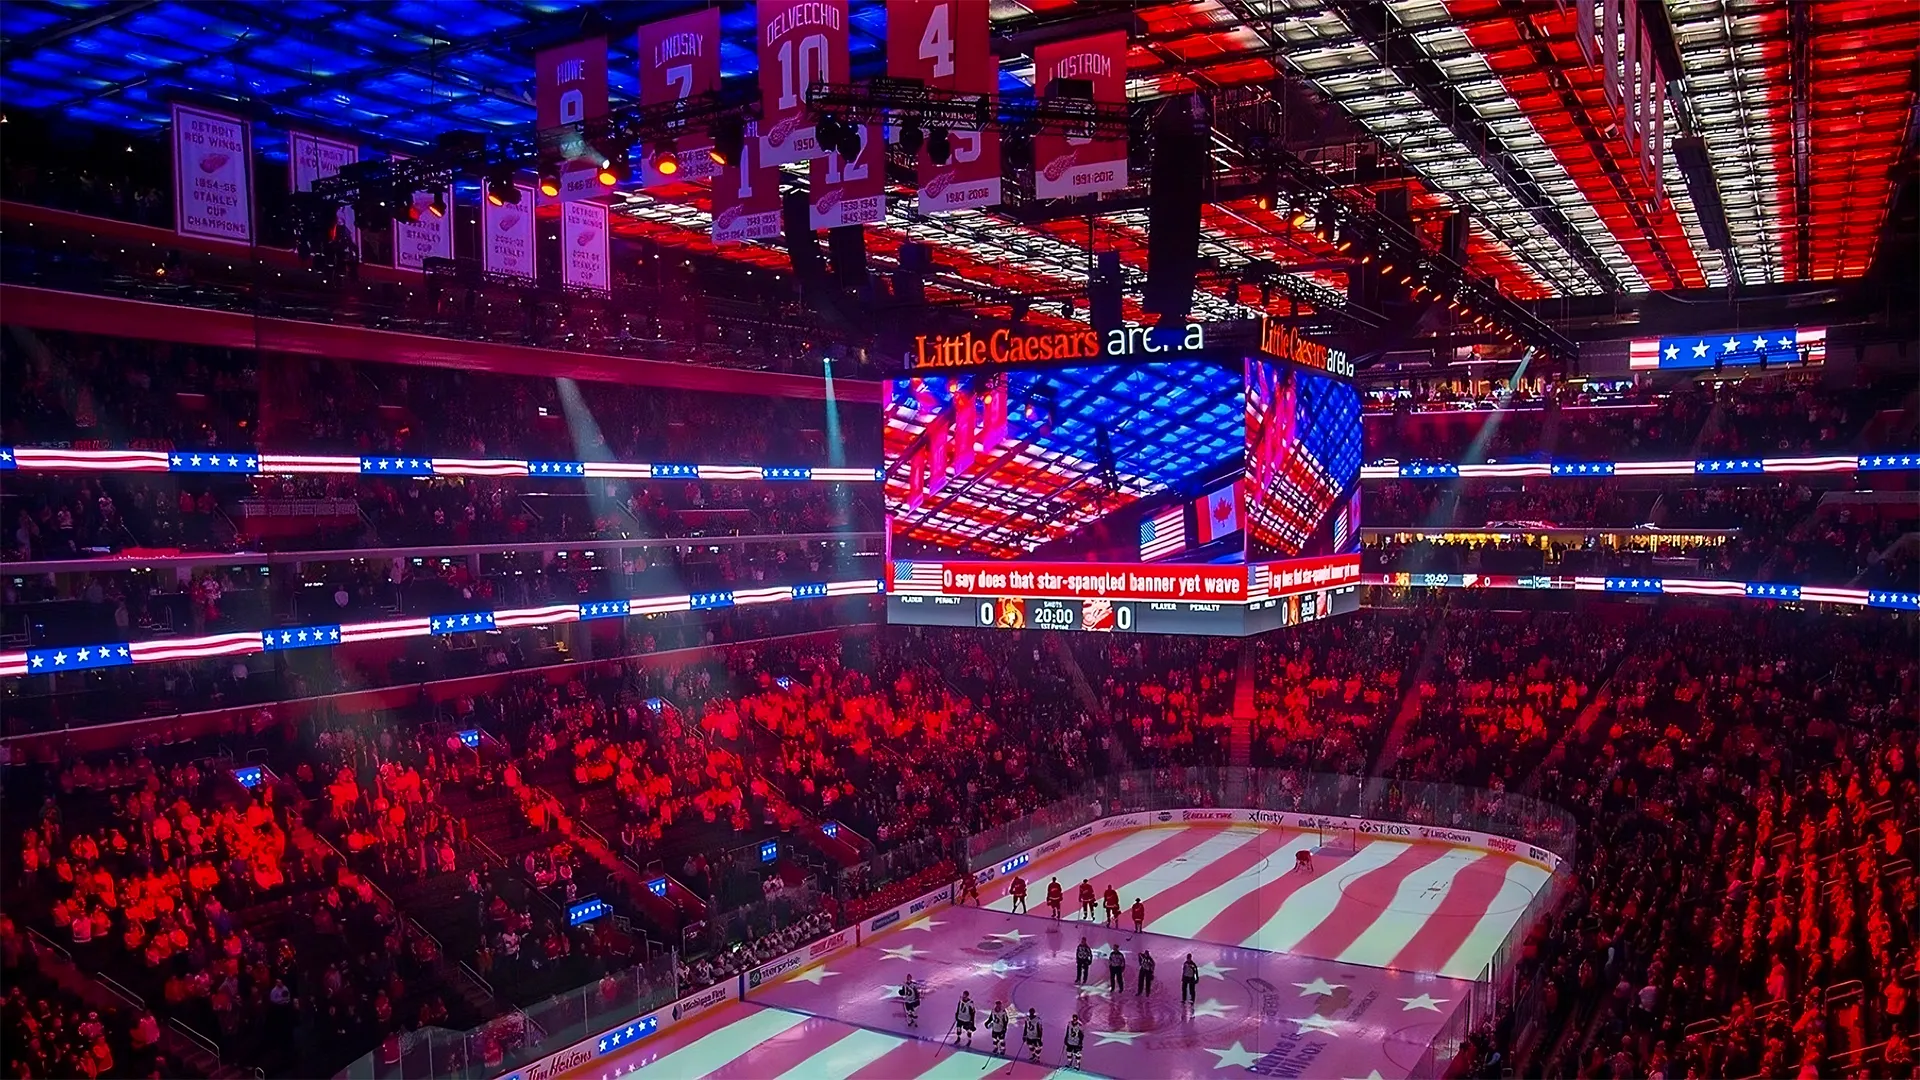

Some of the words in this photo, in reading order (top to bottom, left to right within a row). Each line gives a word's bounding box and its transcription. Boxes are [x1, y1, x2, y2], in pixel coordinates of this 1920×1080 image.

[767, 3, 840, 47] DELVECCHIO
[655, 33, 704, 69] LINDSAY
[919, 3, 954, 78] 4
[557, 60, 586, 87] HOWE
[777, 34, 830, 110] 10
[191, 120, 234, 138] DETROIT
[915, 331, 987, 369] Little
[990, 328, 1100, 364] Caesars
[1107, 323, 1204, 355] area
[1261, 316, 1289, 359] Little
[1290, 326, 1328, 370] Caesars
[955, 573, 977, 593] say
[978, 570, 1007, 589] does
[1009, 571, 1035, 590] that
[1036, 571, 1126, 596] star-spangled
[1129, 572, 1177, 592] banner
[1178, 574, 1201, 597] yet
[1204, 577, 1241, 593] wave
[980, 602, 995, 625] 0
[1034, 608, 1074, 625] 20:00
[1116, 606, 1132, 630] 0
[1248, 810, 1284, 826] xfinity
